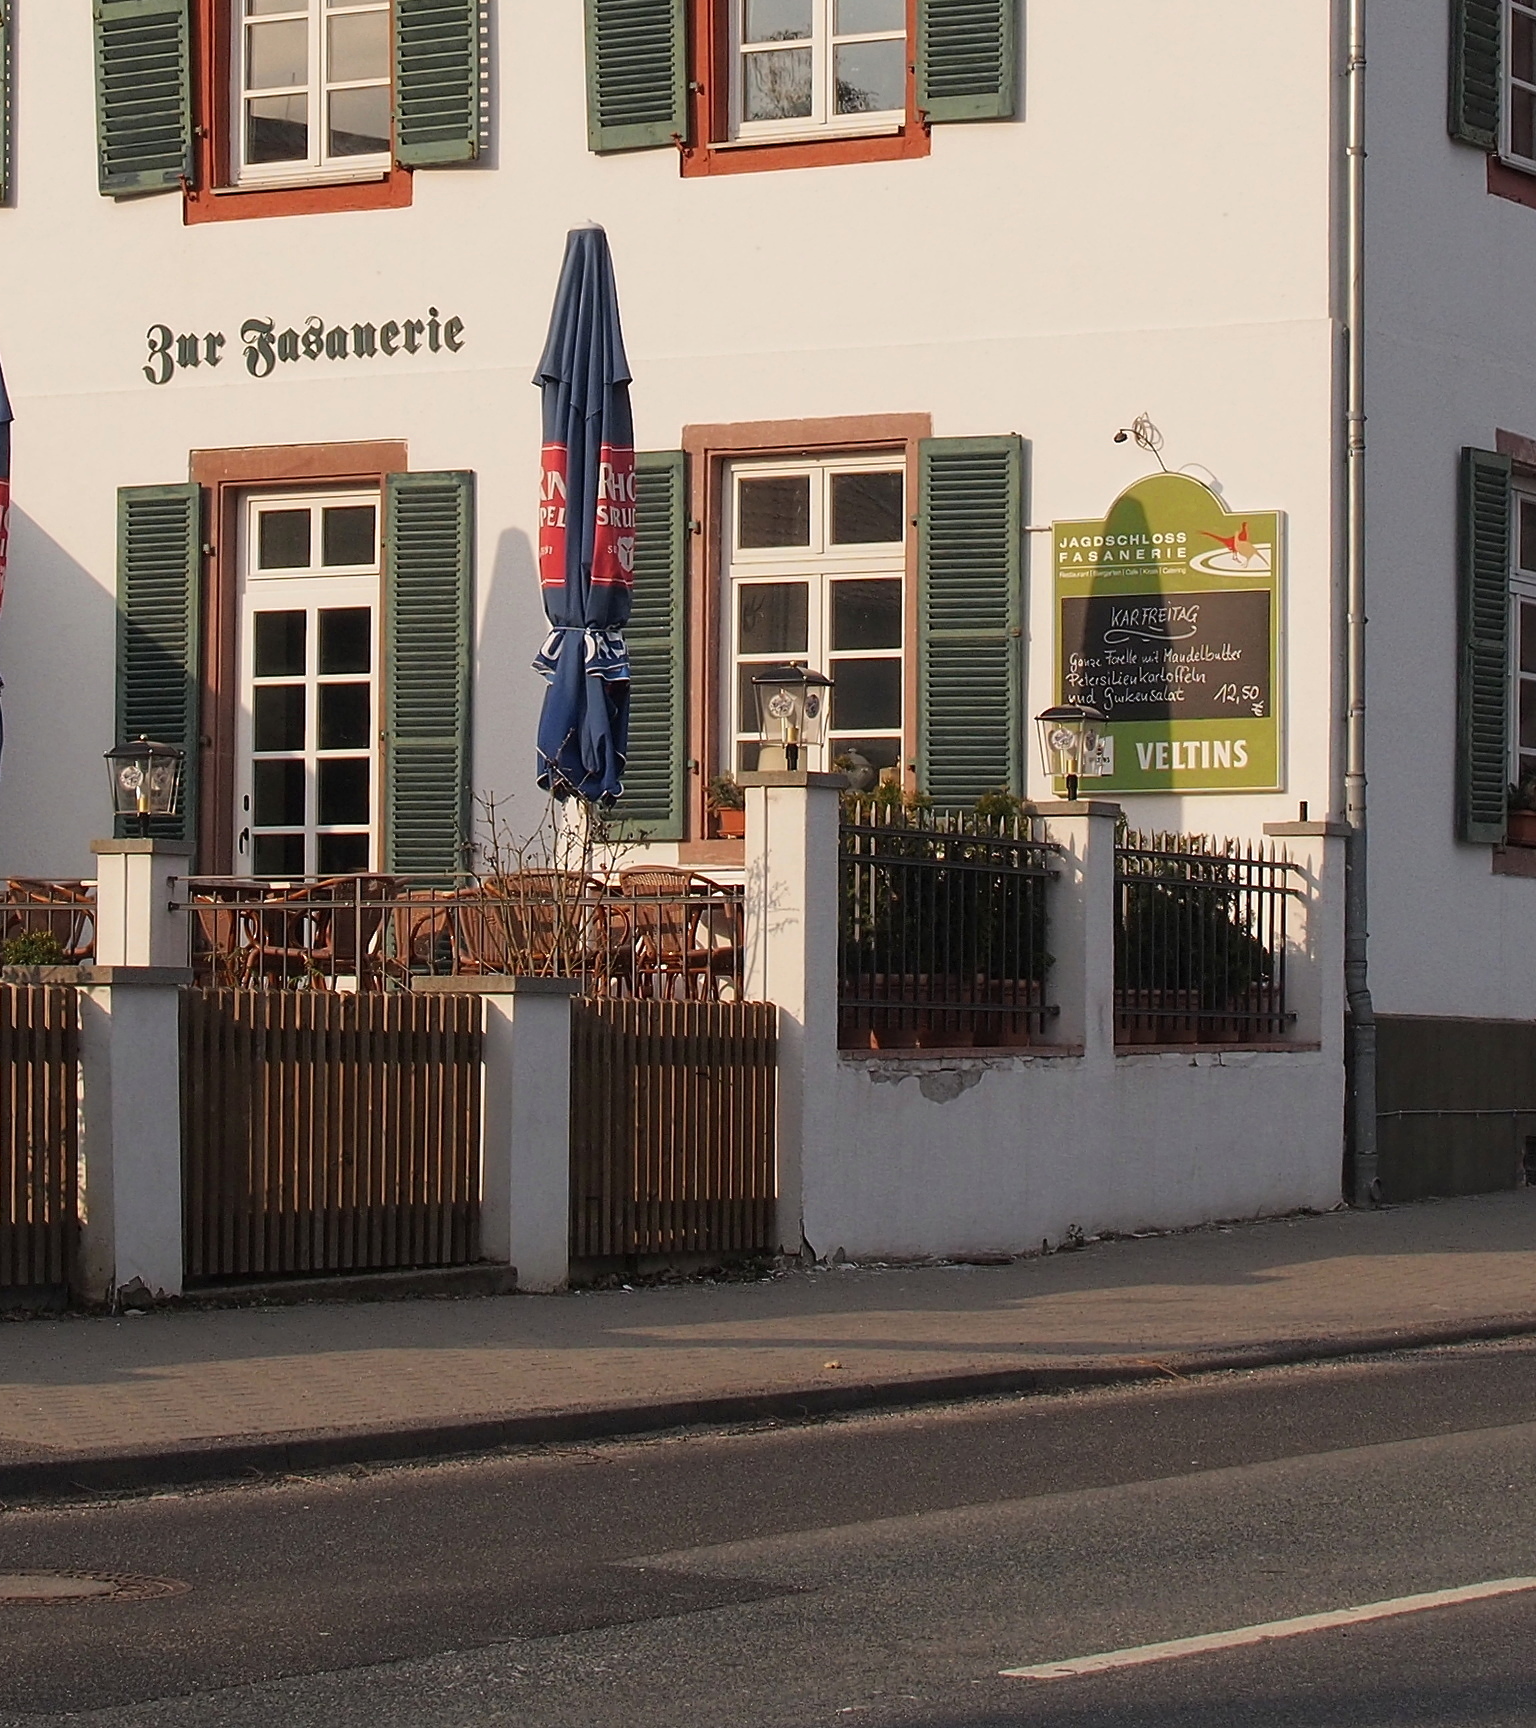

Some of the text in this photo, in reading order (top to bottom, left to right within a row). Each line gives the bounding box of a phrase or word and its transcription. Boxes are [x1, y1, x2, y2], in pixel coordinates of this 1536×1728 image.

[142, 306, 465, 385] Zur Fasanerie
[1059, 532, 1187, 549] JAGDSCHLOSS
[1059, 547, 1187, 563] FASANERIE
[1111, 601, 1200, 628] KARFREITAG
[1142, 650, 1160, 664] mit
[1163, 643, 1243, 664] Mandelbutter
[1067, 687, 1097, 706] und
[1213, 683, 1261, 705] 12,50
[1135, 739, 1249, 771] VELTINS
